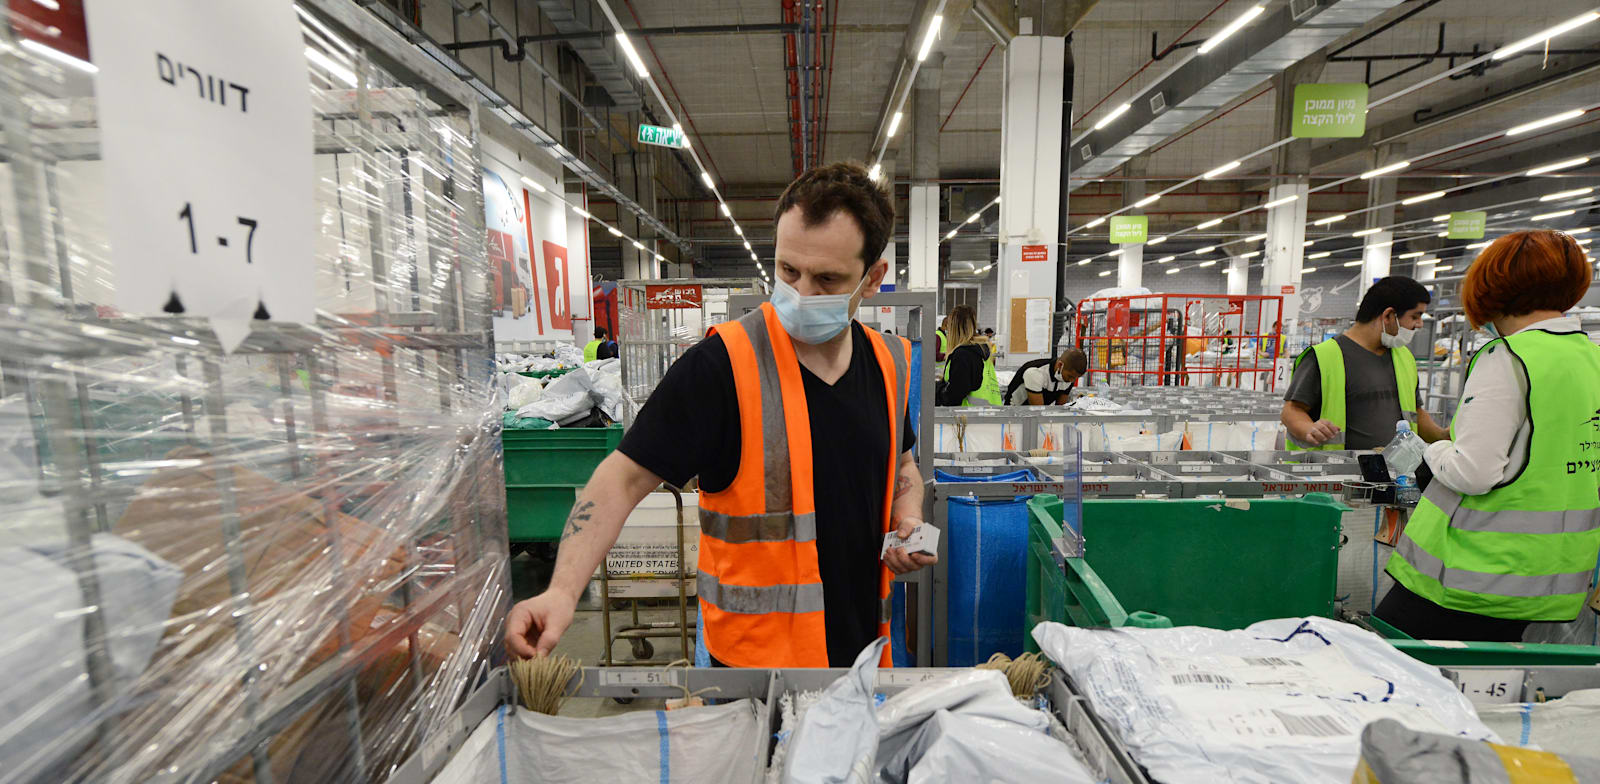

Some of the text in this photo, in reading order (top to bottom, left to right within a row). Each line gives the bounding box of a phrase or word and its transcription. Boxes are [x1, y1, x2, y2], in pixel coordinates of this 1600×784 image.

[156, 52, 250, 113] דוורים
[1304, 98, 1356, 113] מיון ממוכן
[1302, 112, 1334, 127] הקצה
[180, 202, 197, 254] 1
[238, 216, 258, 264] 7
[1278, 365, 1284, 381] 2
[1262, 482, 1299, 493] ישראל
[1303, 482, 1329, 493] דואר
[608, 560, 643, 568] UNITED
[616, 673, 622, 682] 1
[647, 672, 661, 682] 51
[890, 673, 895, 683] 1
[1485, 682, 1507, 697] 45
